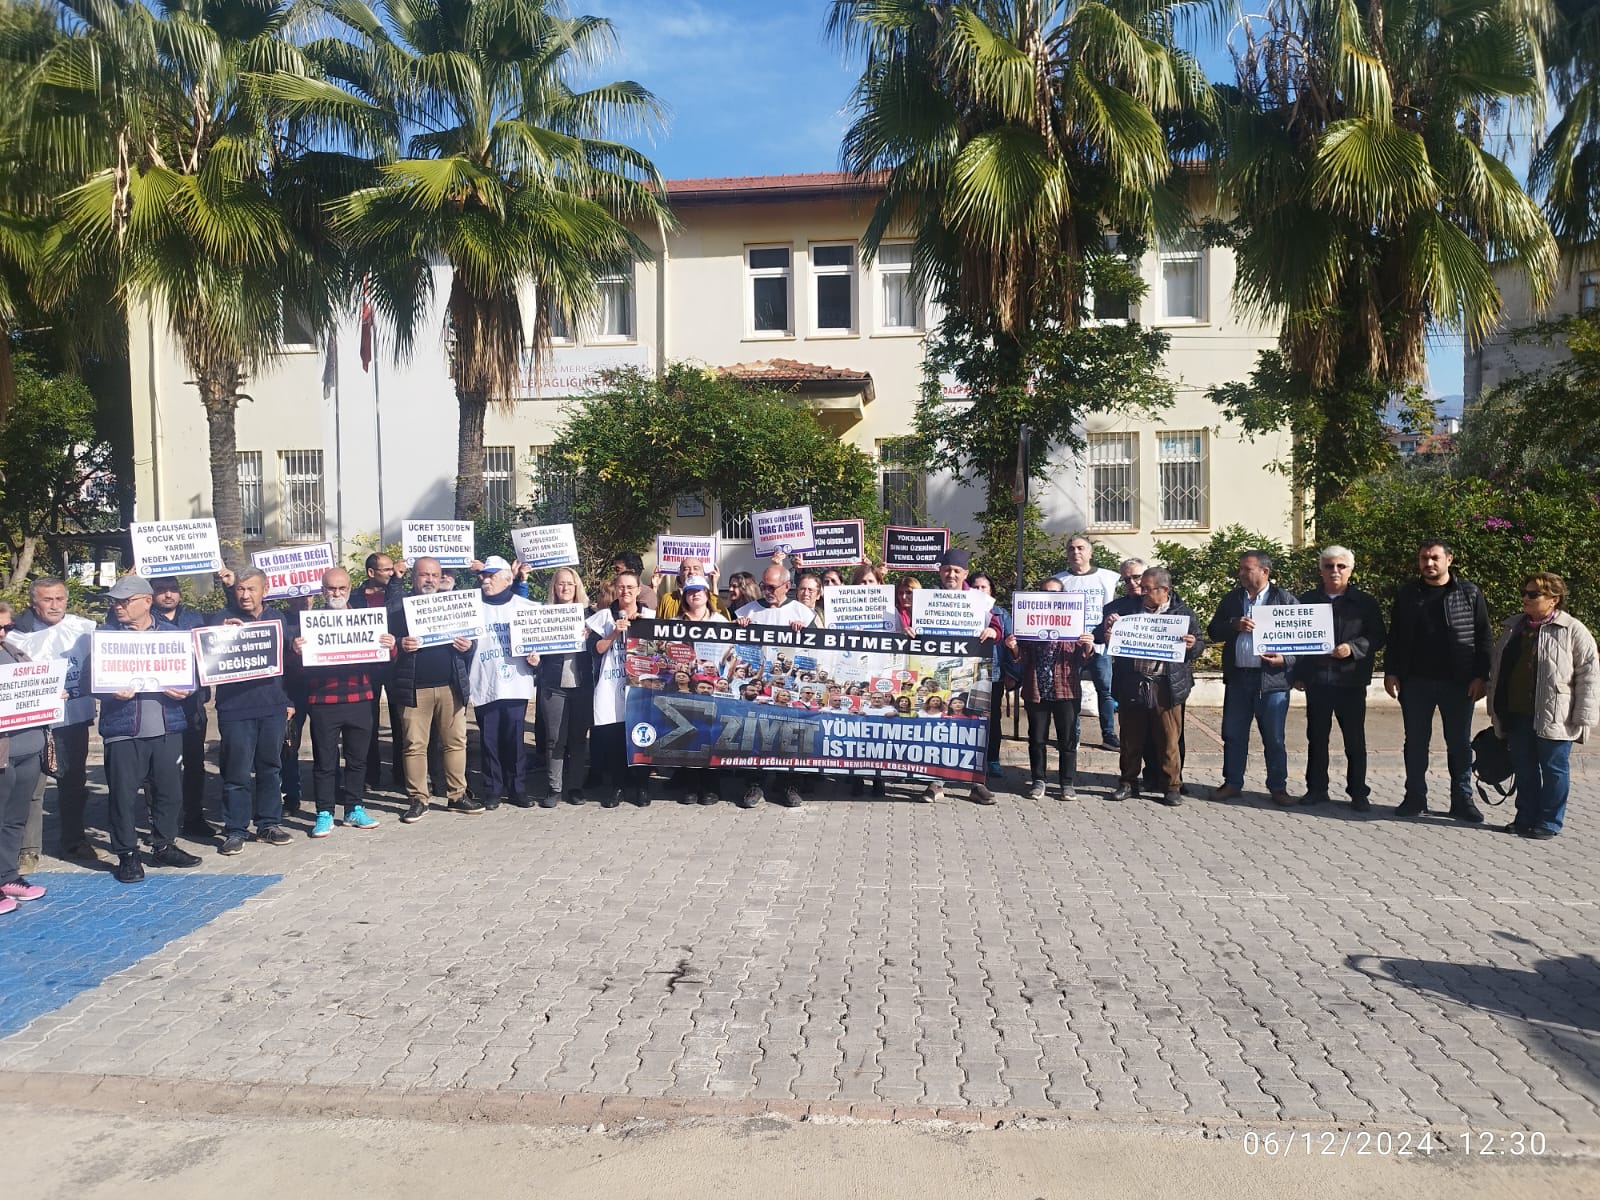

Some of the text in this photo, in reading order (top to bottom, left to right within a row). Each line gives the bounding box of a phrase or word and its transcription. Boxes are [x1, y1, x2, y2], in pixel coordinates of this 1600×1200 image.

[138, 522, 213, 534] ASM ÇALIŞANLARINA
[409, 521, 435, 531] ÜCRET
[759, 521, 804, 535] ENAG'A GÖRE
[147, 531, 208, 544] ÇOCUK VE GİYİM
[417, 534, 463, 542] DENETLEME
[897, 534, 935, 542] YOKSULLUK
[164, 543, 195, 551] YARDIMI
[409, 545, 427, 553] 3500
[663, 546, 710, 556] AYRILAN PAY
[142, 554, 168, 564] NEDEN
[260, 547, 329, 568] EK ÖDEME DEĞİL
[916, 553, 937, 561] ÜCRET
[410, 591, 476, 606] YENİ ÜCRETLERİ
[869, 595, 888, 603] DEĞİL
[416, 601, 473, 615] HESAPLAMAYA
[539, 606, 577, 615] YÖNETMELİĞİ
[1053, 601, 1083, 610] PAYIMIZI
[1272, 608, 1295, 616] ÖNCE
[306, 613, 384, 628] SAĞLIK HAKTIR
[543, 616, 582, 624] GRUPLARININ
[1026, 612, 1072, 626] İSTİYORUZ
[1274, 618, 1312, 629] HEMŞİRE
[240, 629, 271, 640] ÜRETEN
[318, 631, 375, 645] SATILAMAZ
[654, 623, 969, 654] MÜCADELEMİZ BİTMEYECEK
[1114, 630, 1155, 639] GÜVENCESİNİ
[1262, 629, 1326, 641] AÇIĞINI GİDER!
[101, 641, 186, 655] SERMAYEYE DEĞİL
[242, 640, 272, 651] SİSTEMİ
[102, 658, 187, 674] EMEKÇİYE BÜTÇE
[218, 654, 268, 671] DEĞİŞSİN
[13, 662, 49, 677] ASM'LERİ
[40, 676, 60, 686] KADAR
[15, 699, 40, 710] DENETLE
[821, 718, 987, 748] YÖNETMELİĞİNİ
[822, 736, 985, 771] İSTEMİYORUZ!
[720, 756, 758, 766] FORMÜL
[759, 757, 793, 766] DEĞİLİZ!
[794, 758, 811, 766] AİLE
